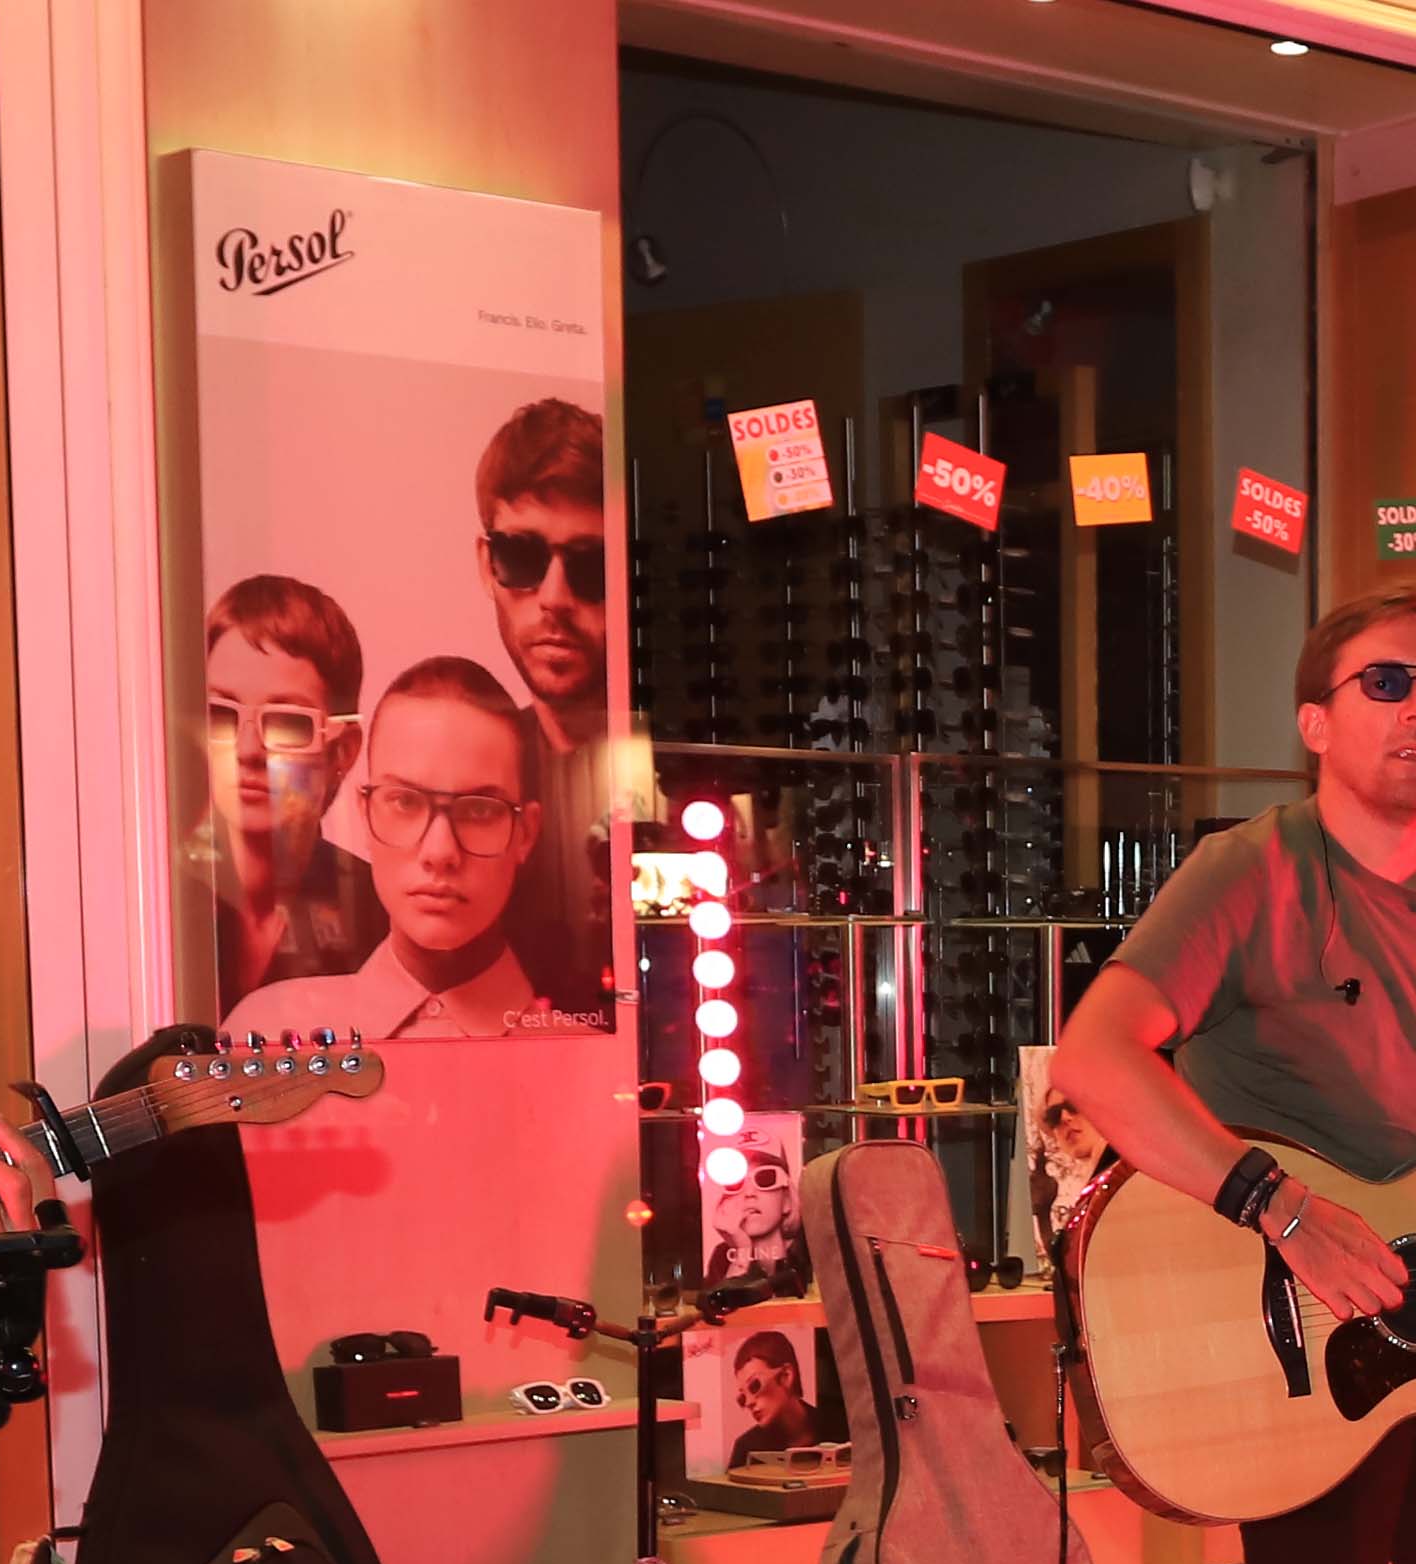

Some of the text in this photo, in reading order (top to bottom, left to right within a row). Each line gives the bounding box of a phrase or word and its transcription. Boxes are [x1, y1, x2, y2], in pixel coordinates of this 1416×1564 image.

[217, 208, 354, 295] Persol
[733, 407, 815, 442] SOLDES
[922, 458, 996, 507] -50%
[1075, 475, 1146, 501] -40%
[1240, 477, 1302, 517] SOLDES
[1245, 509, 1289, 541] -50%
[503, 1008, 609, 1028] C'est Persol.
